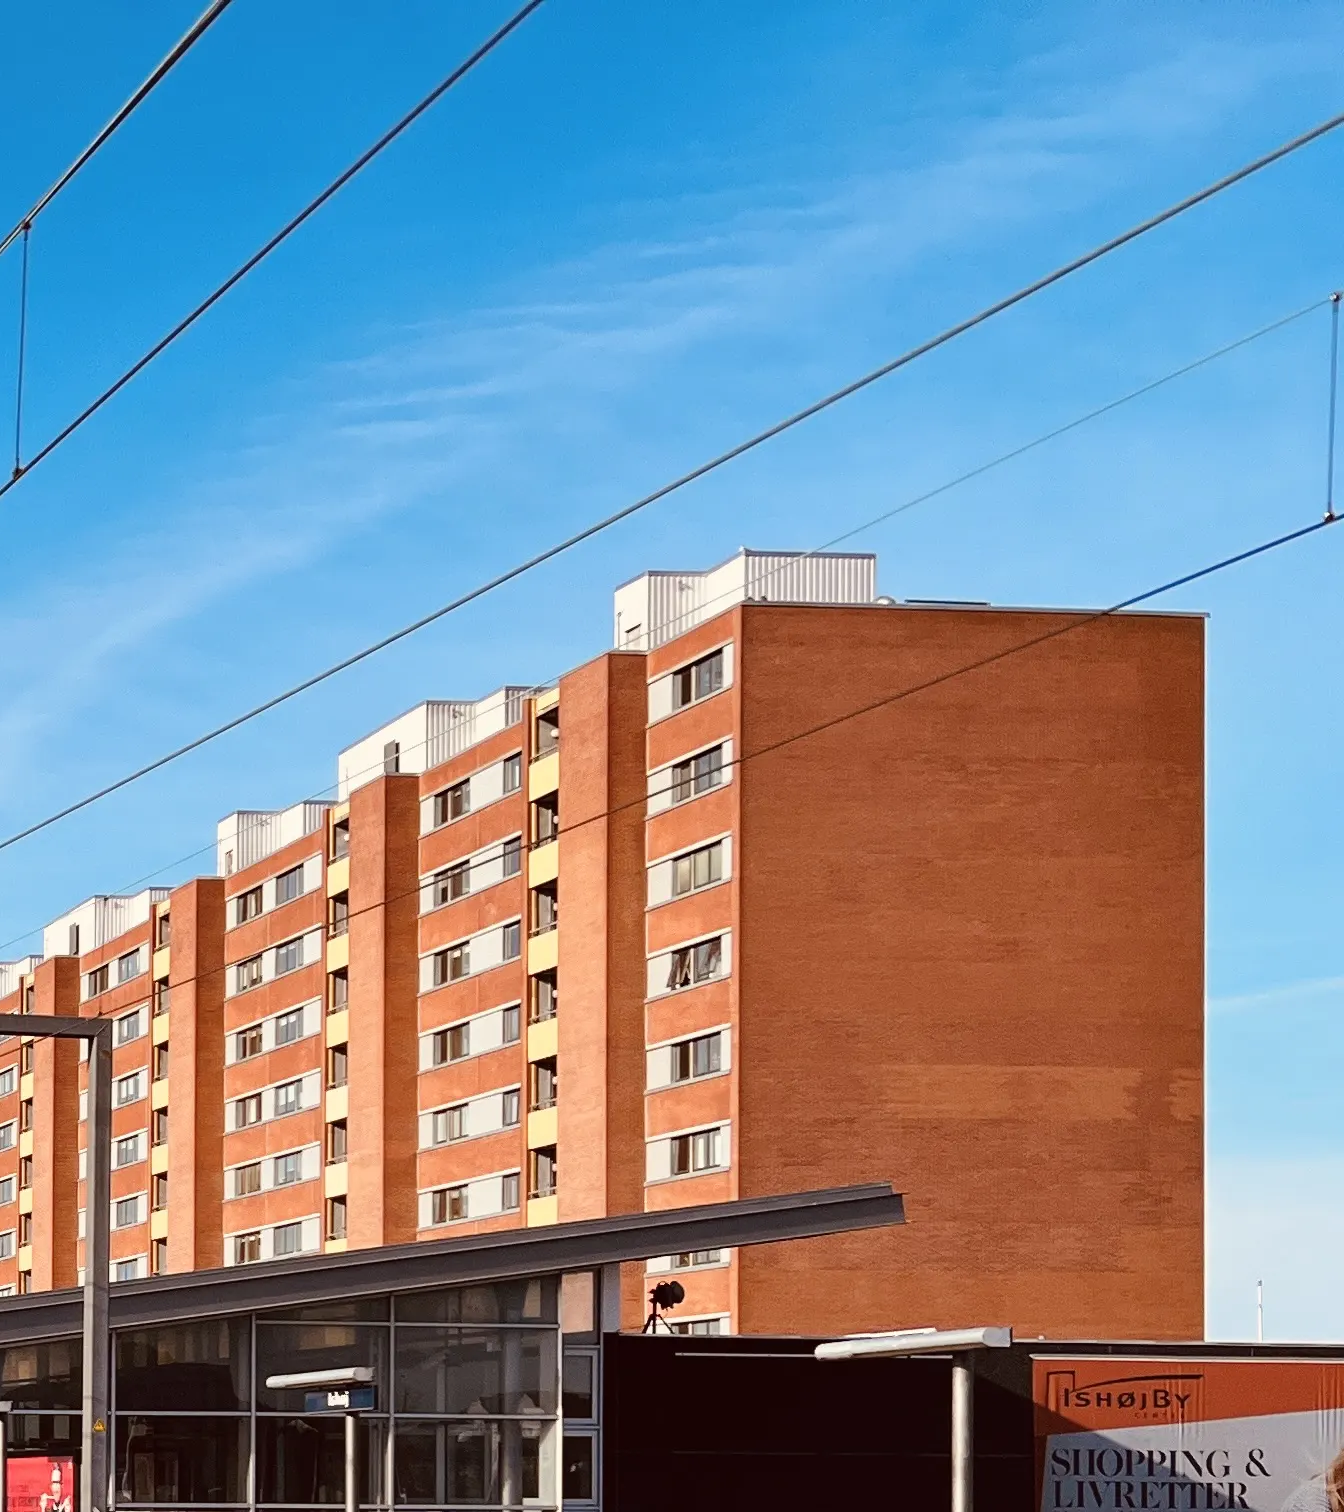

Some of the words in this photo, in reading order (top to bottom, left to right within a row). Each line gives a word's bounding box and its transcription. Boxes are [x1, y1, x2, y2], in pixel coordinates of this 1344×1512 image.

[1051, 1449, 1231, 1477] SHOPPING
[1245, 1449, 1271, 1477] &
[1053, 1481, 1250, 1509] LIVRETTER
